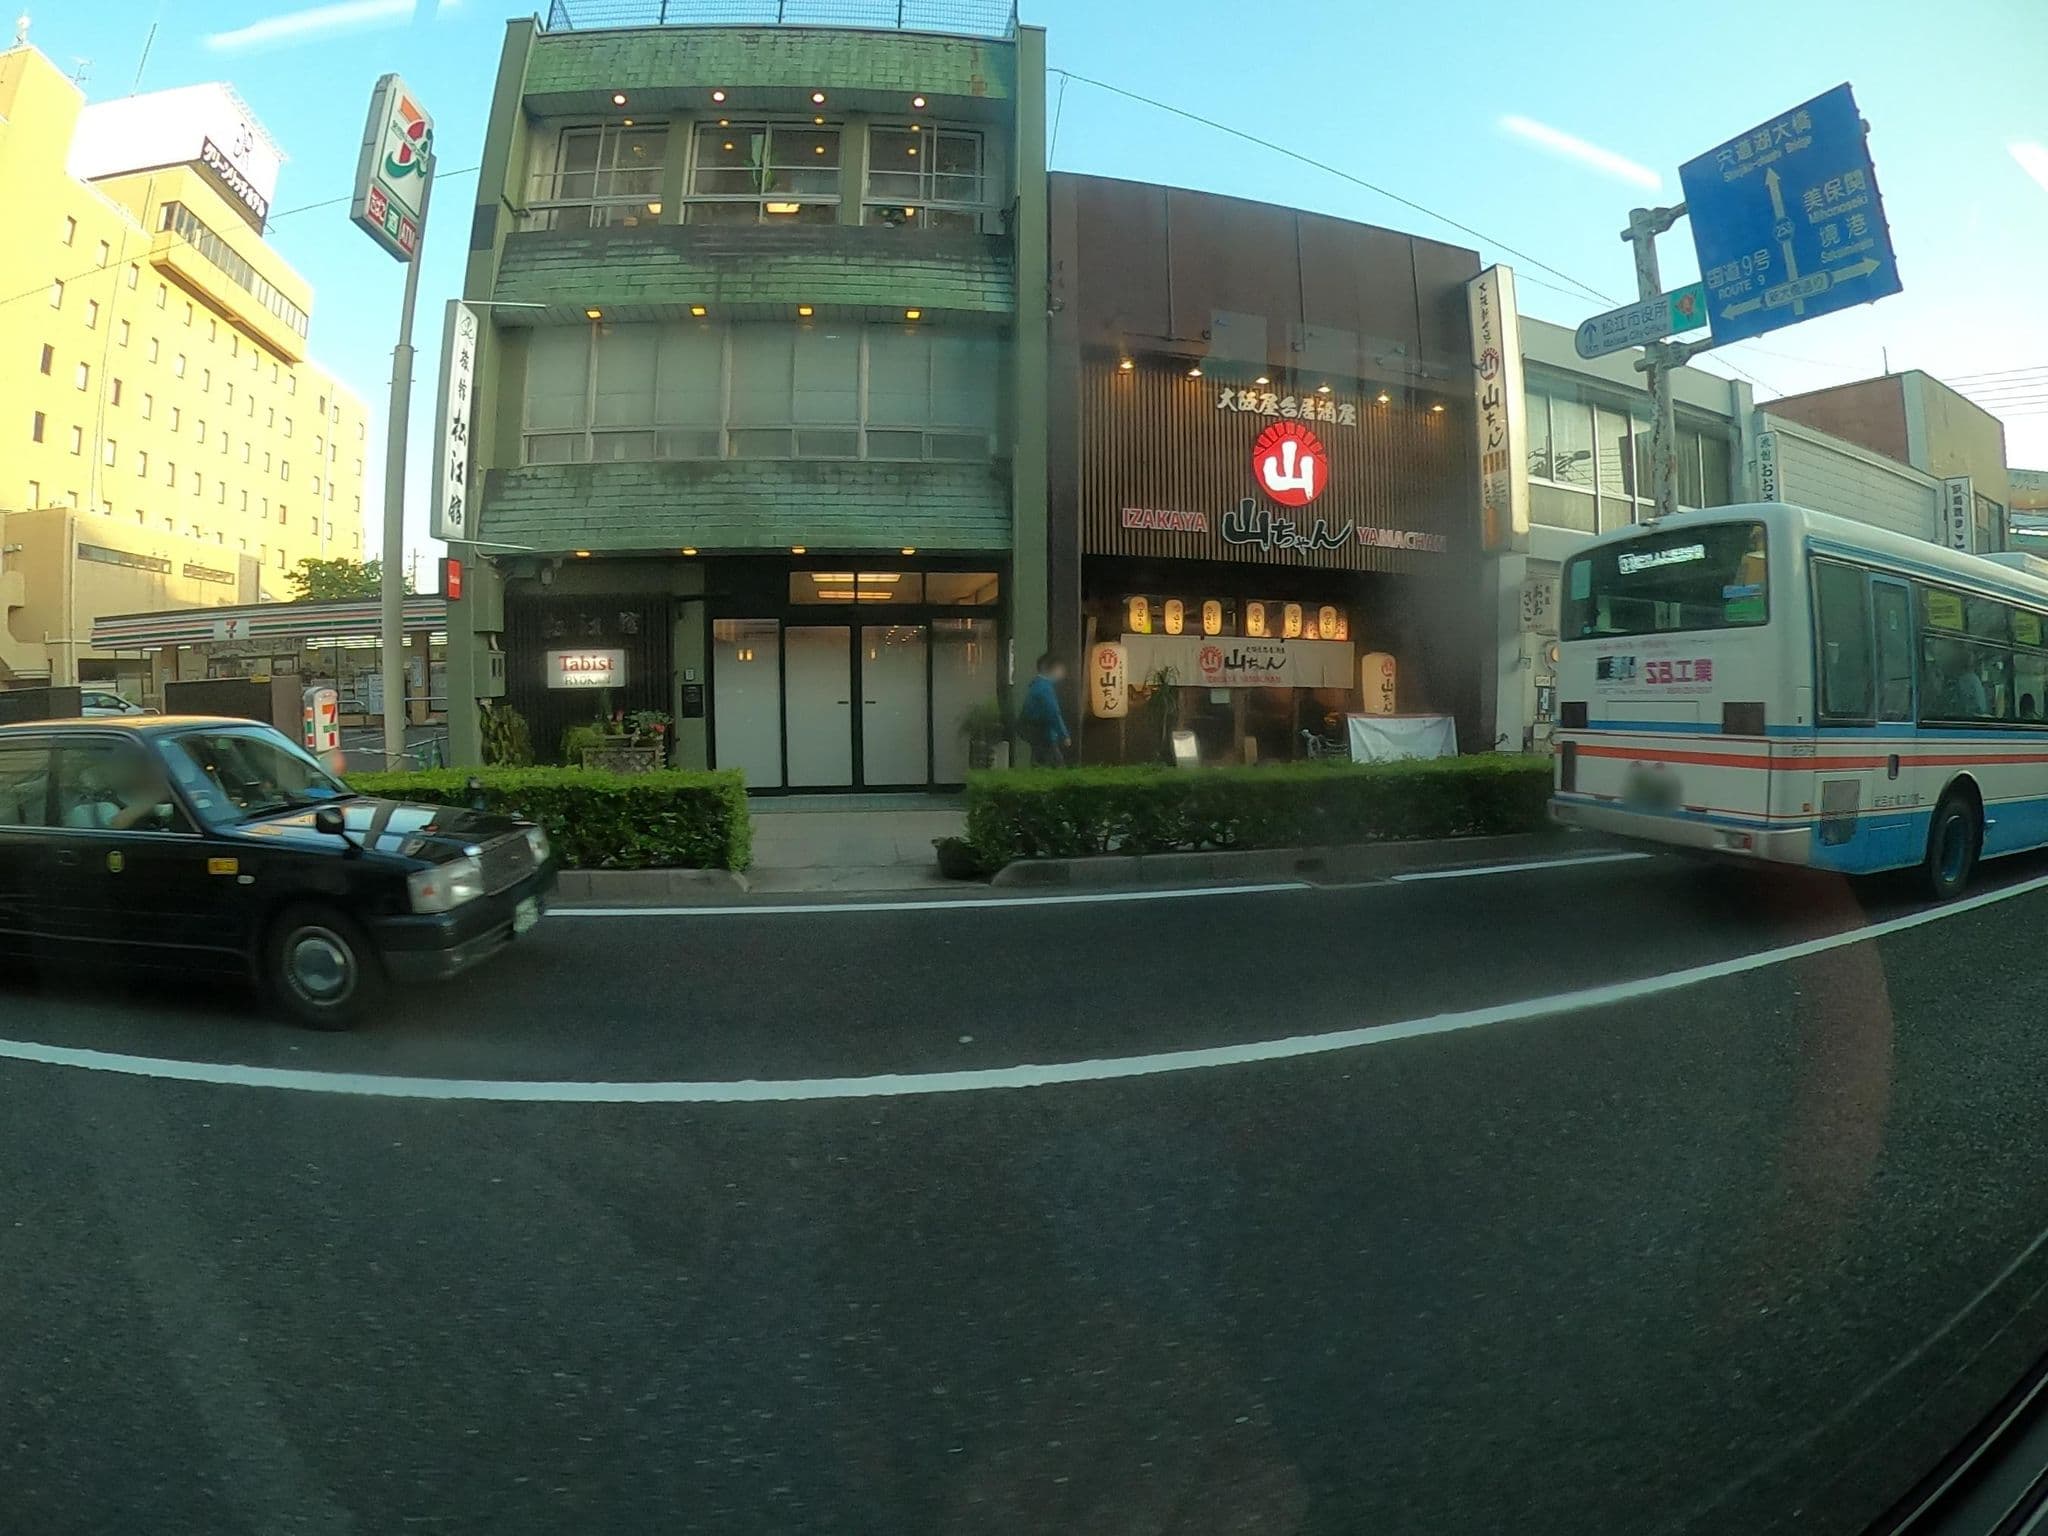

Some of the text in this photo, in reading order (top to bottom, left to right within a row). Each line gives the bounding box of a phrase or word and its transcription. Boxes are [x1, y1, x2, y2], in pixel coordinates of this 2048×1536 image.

[1718, 274, 1766, 300] ROUTE 9
[1217, 387, 1357, 427] 大阪屋台居酒屋
[1263, 440, 1314, 501] 山
[1121, 508, 1208, 533] IZAKAYA
[1222, 498, 1352, 554] 山ちゃん
[1357, 526, 1447, 553] YAMACHAN
[559, 655, 615, 672] Tabist
